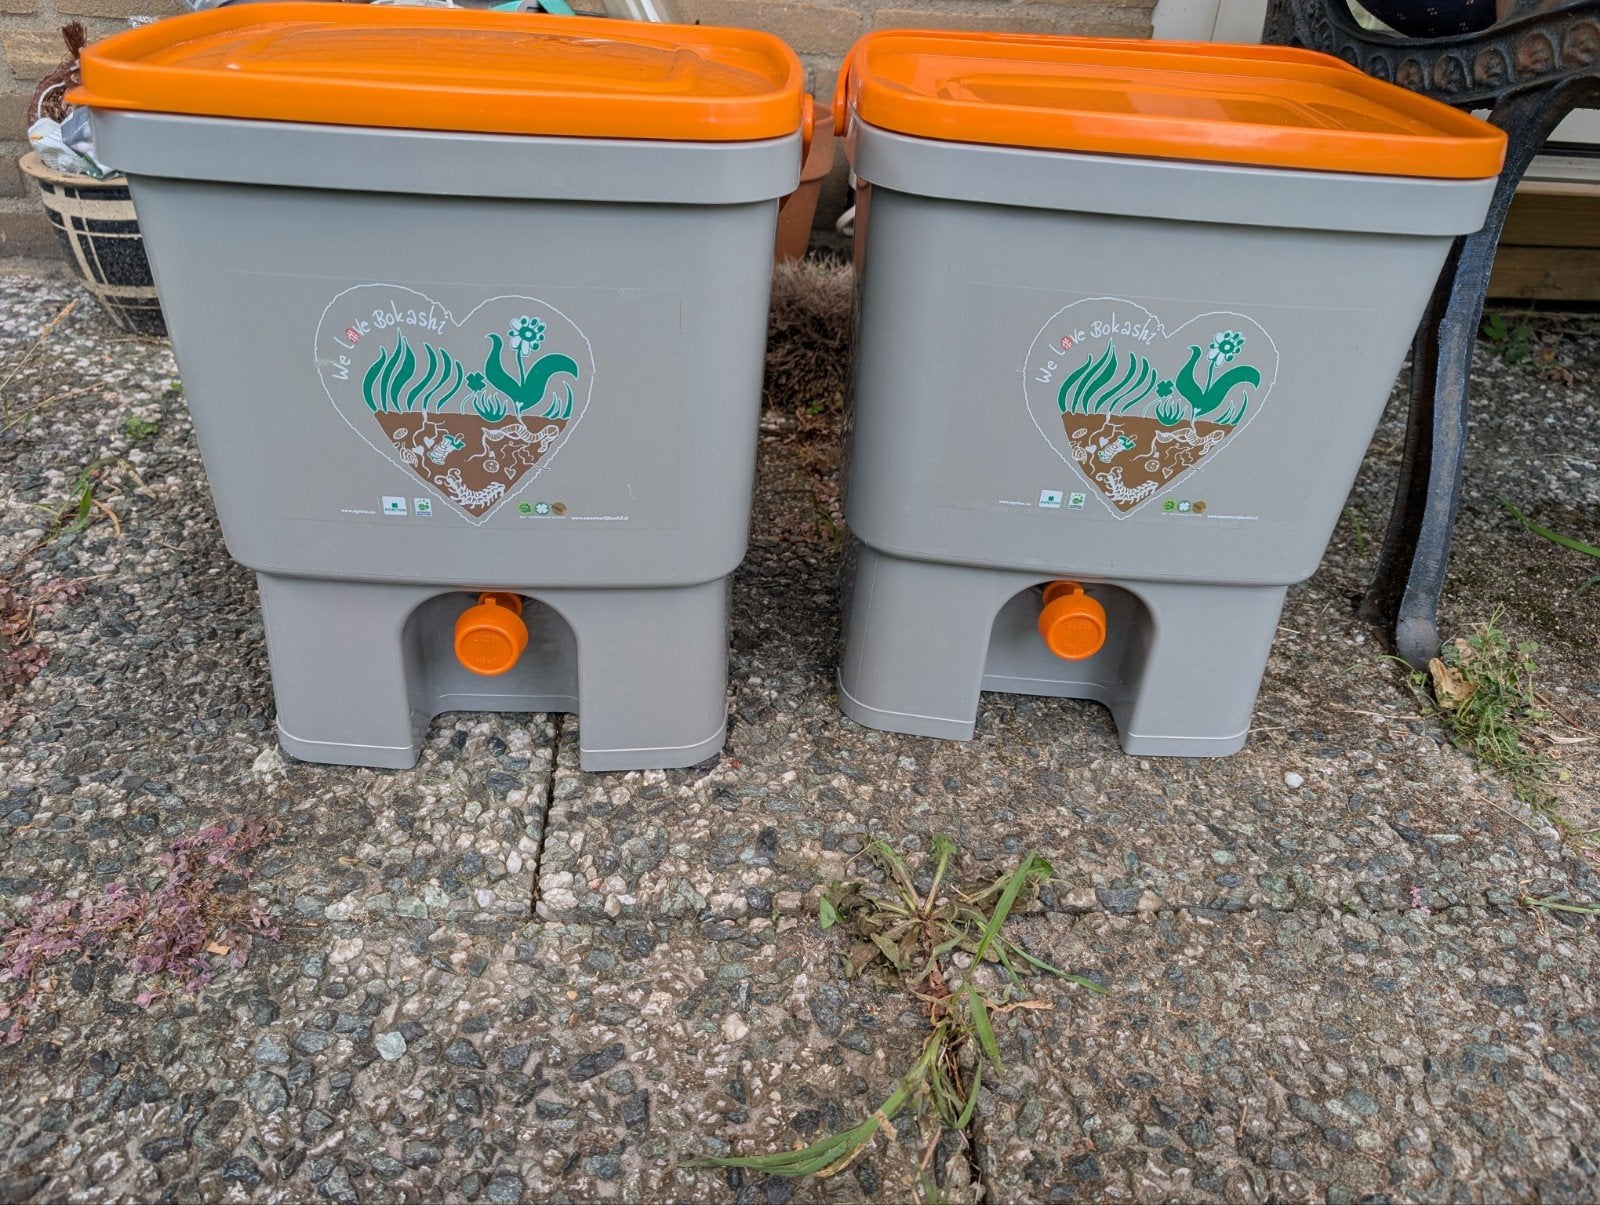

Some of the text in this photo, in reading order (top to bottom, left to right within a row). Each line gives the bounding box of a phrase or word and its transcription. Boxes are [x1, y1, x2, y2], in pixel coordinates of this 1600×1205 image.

[332, 355, 351, 380] We
[372, 299, 447, 335] Bokashi
[1035, 360, 1058, 384] We
[1090, 312, 1160, 345] Bokashi
[475, 657, 499, 665] OPEN
